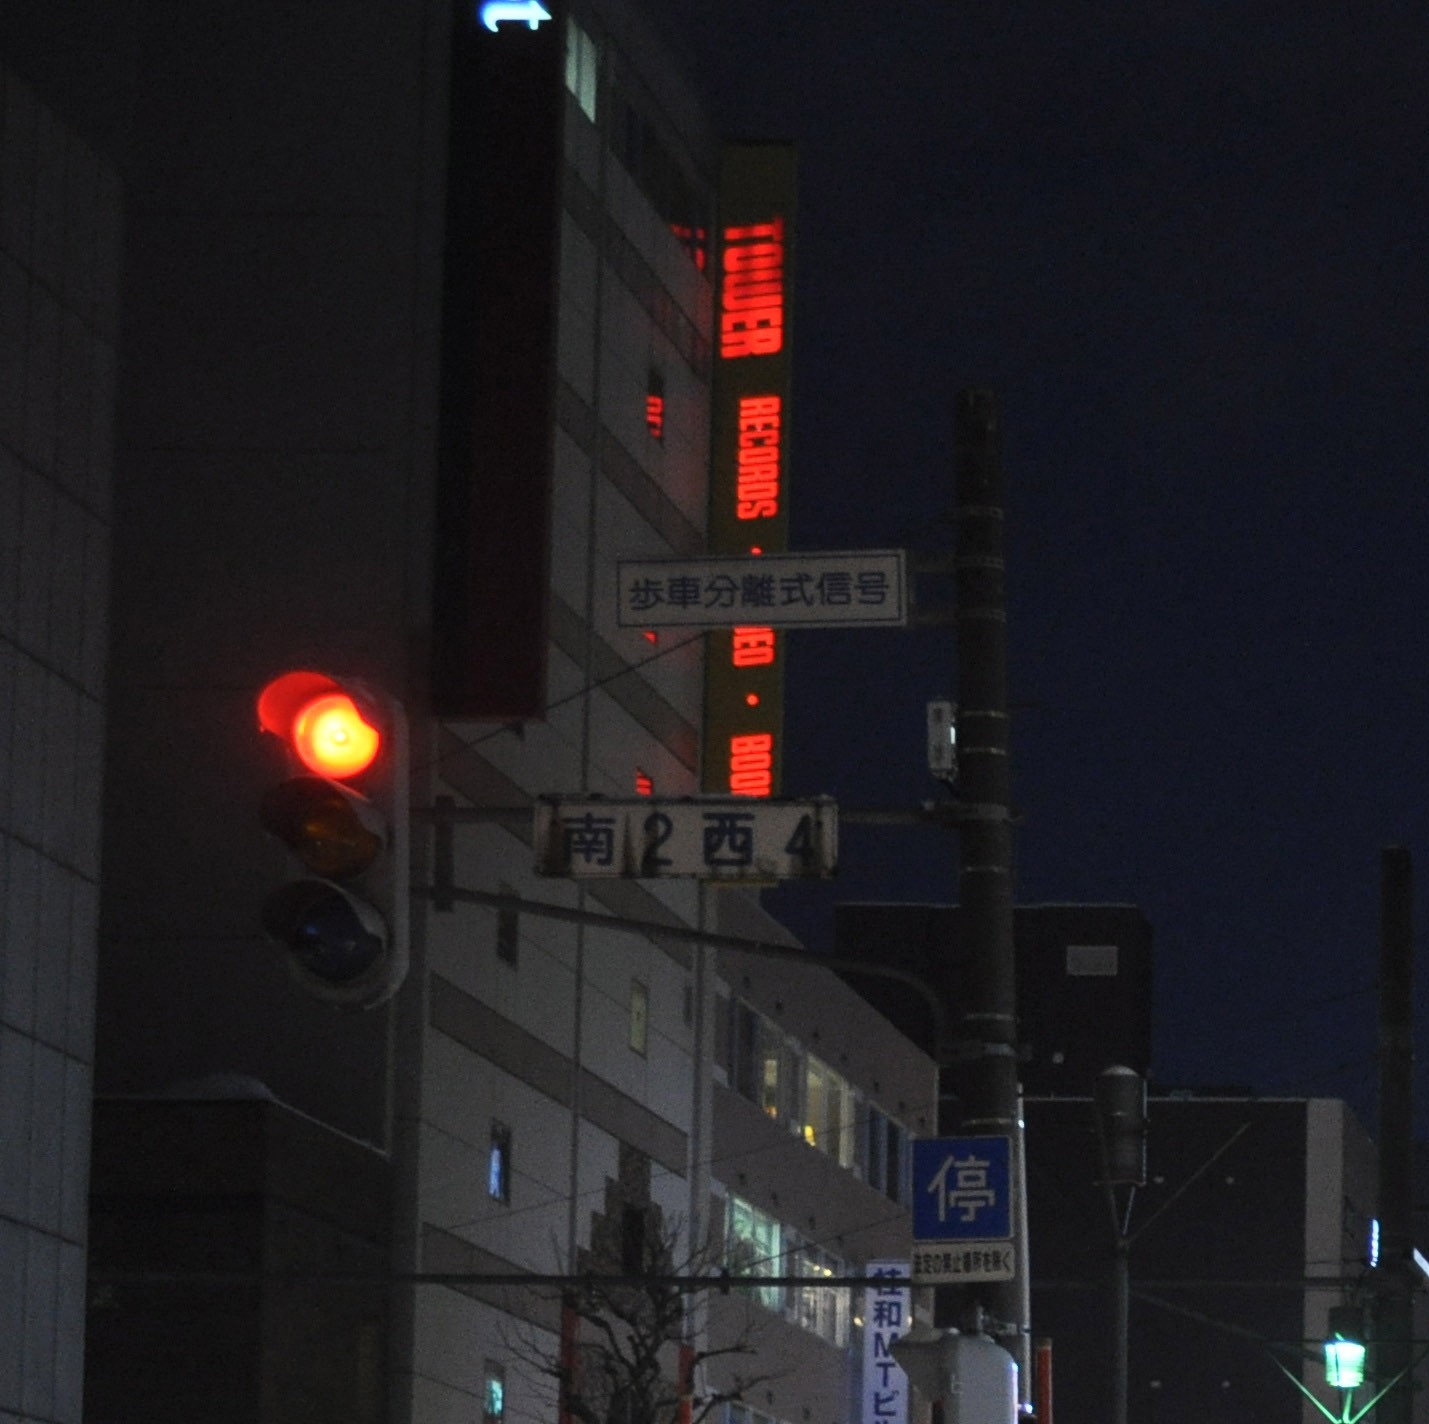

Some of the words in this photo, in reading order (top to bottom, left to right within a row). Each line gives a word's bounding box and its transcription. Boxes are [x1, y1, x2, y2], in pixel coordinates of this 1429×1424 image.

[720, 217, 784, 358] TOWER
[736, 396, 781, 520] RECORDS
[628, 571, 891, 612] 歩車分離式信号
[564, 813, 820, 867] 南2西4
[927, 1154, 996, 1222] 停
